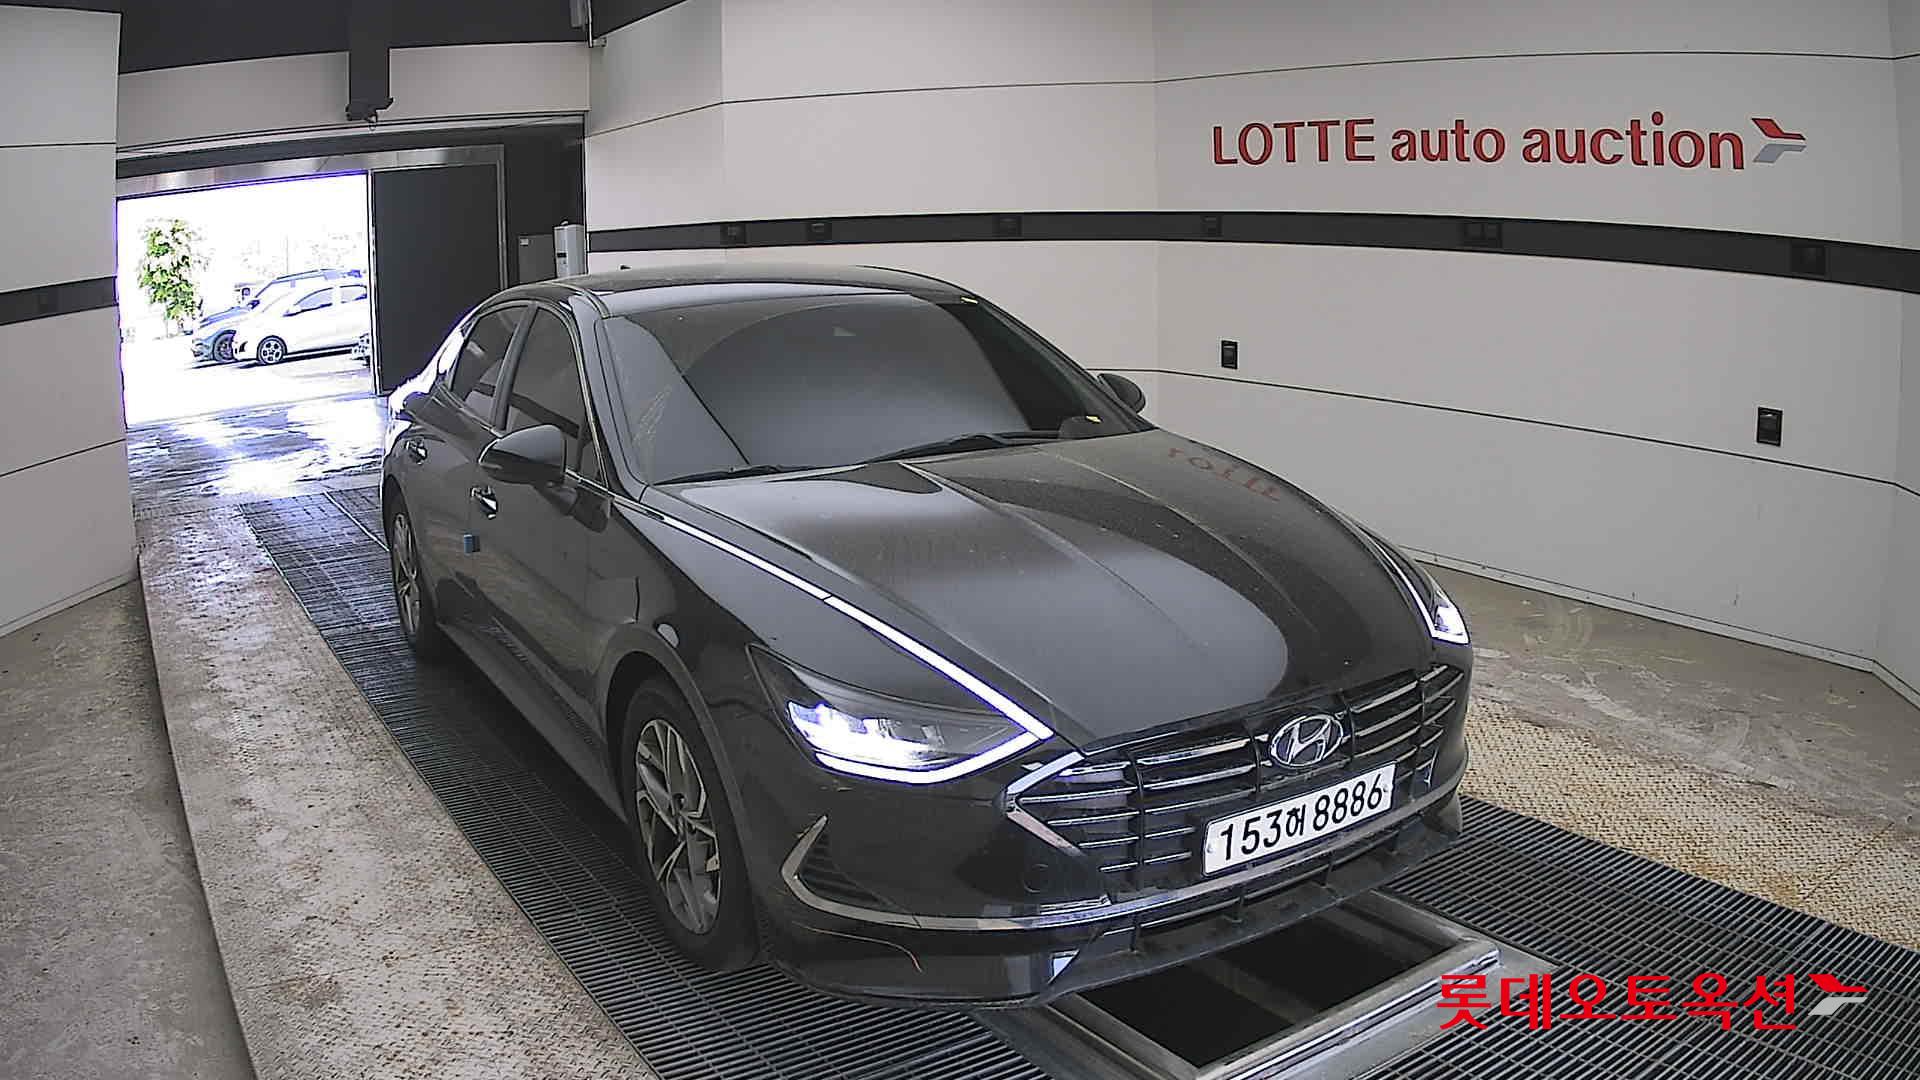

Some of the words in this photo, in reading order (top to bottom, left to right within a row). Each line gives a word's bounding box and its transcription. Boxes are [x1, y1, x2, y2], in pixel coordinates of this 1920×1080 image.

[1212, 118, 1376, 166] LOTTE
[1390, 119, 1506, 163] auto
[1521, 111, 1745, 170] auction
